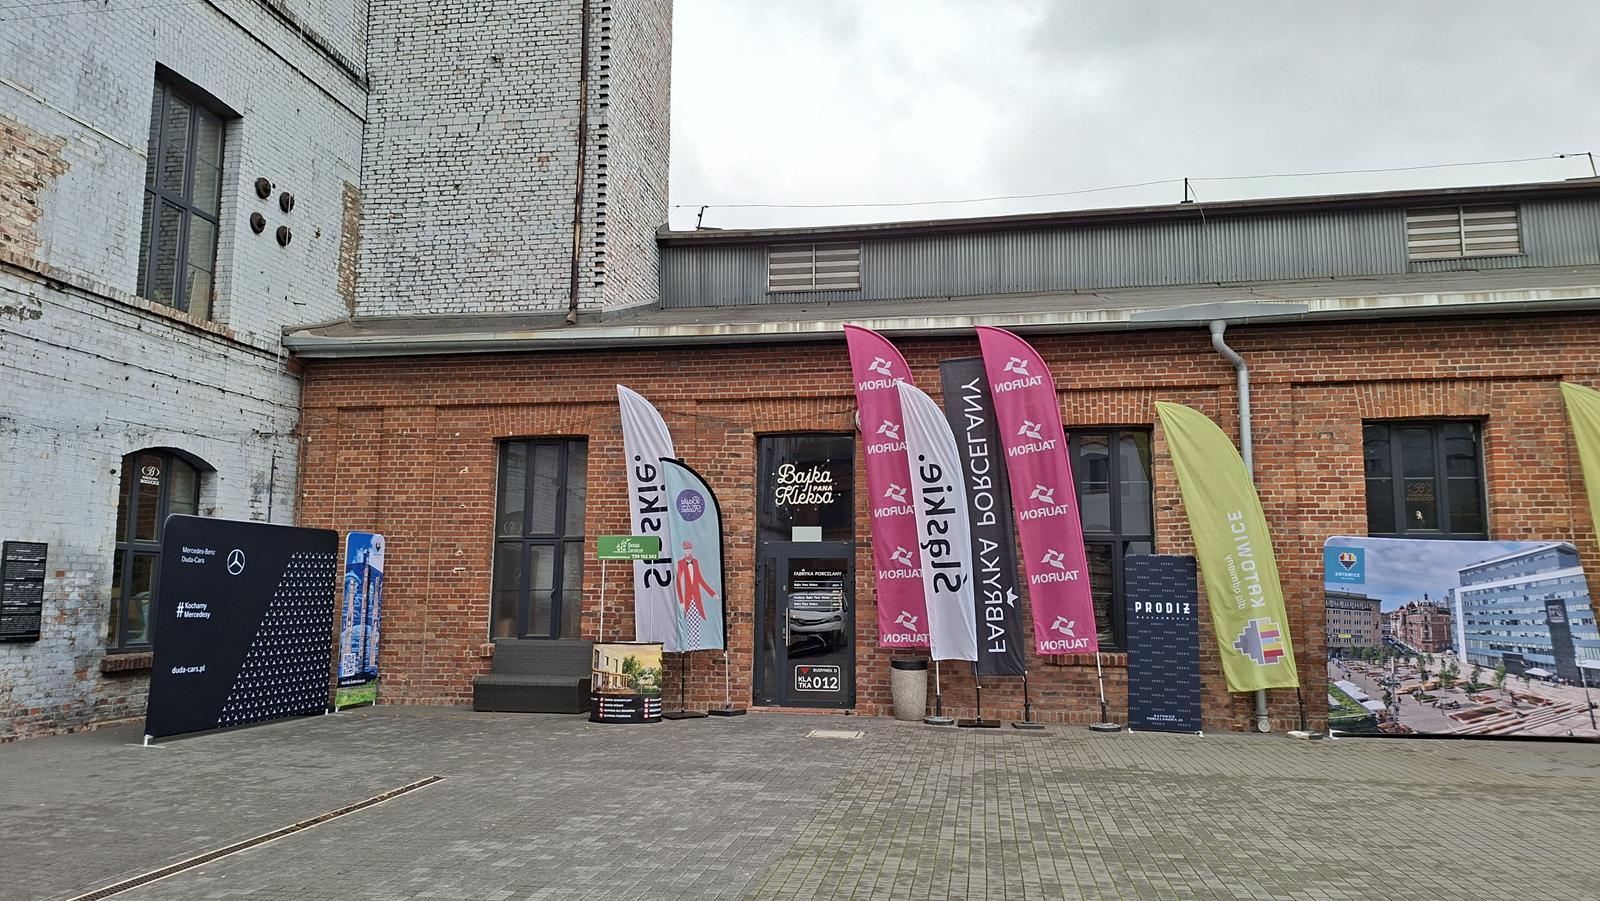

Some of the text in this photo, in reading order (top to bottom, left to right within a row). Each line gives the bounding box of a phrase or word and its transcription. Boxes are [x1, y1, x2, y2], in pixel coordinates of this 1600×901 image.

[777, 464, 832, 491] Bajka
[775, 485, 834, 505] Kleksa
[182, 546, 216, 556] Mercedes-Benz
[181, 556, 205, 564] Duda-Cars
[184, 602, 207, 611] Kochamy
[183, 610, 211, 620] Mercedesy
[171, 664, 206, 674] duda-cars.pl
[813, 676, 838, 689] 012
